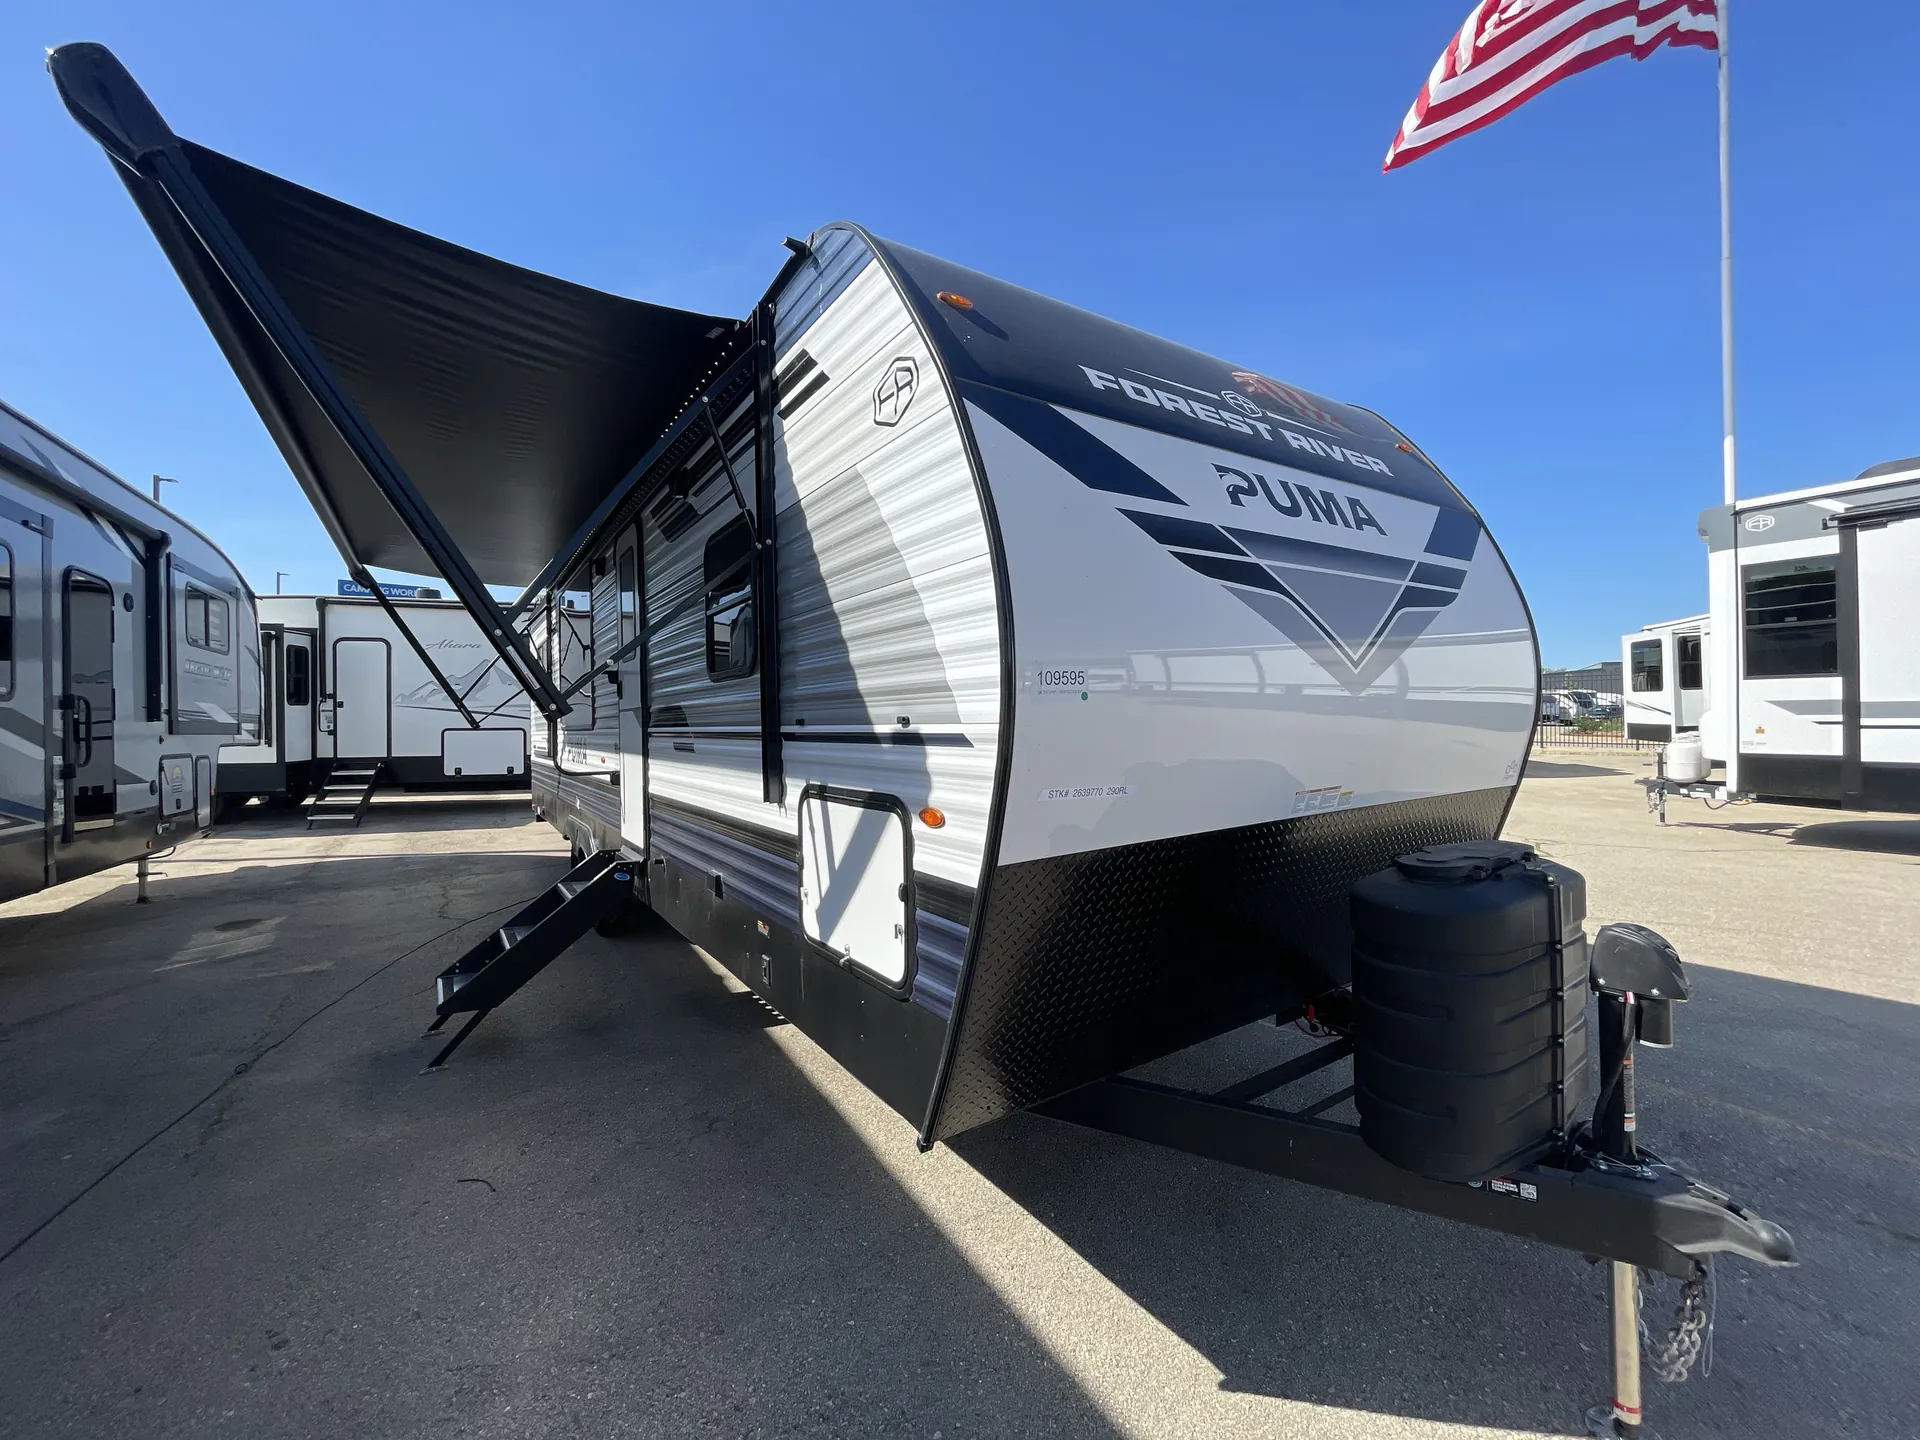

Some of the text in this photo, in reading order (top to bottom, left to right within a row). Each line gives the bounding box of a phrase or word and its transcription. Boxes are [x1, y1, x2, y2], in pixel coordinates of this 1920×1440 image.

[1077, 364, 1395, 478] FOREST RIVER
[1209, 462, 1389, 537] PUMA
[343, 584, 417, 597] CAMG WOR
[1037, 670, 1085, 686] 109595
[1047, 786, 1129, 799] STK# 2639770 290RL
